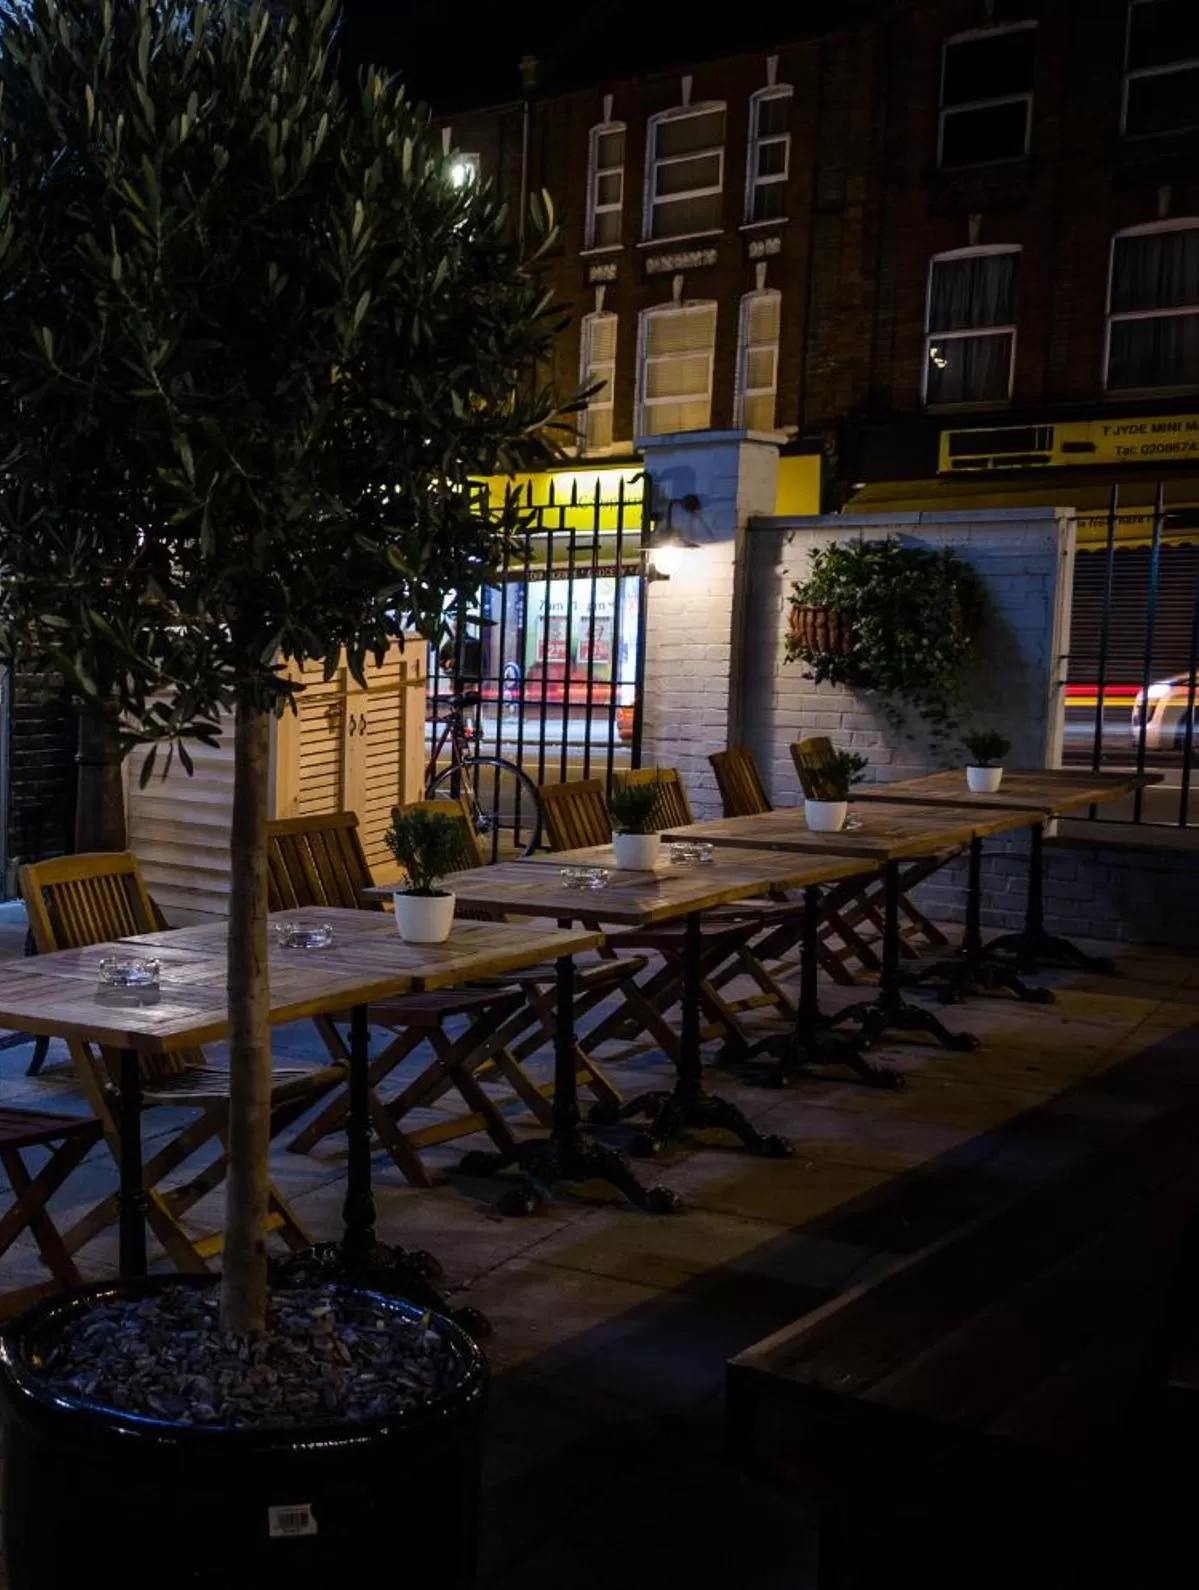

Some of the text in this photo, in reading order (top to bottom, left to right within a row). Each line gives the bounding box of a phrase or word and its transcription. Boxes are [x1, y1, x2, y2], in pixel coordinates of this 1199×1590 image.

[1151, 421, 1182, 433] MINI
[1186, 420, 1199, 432] M
[1140, 441, 1199, 455] 0208674
